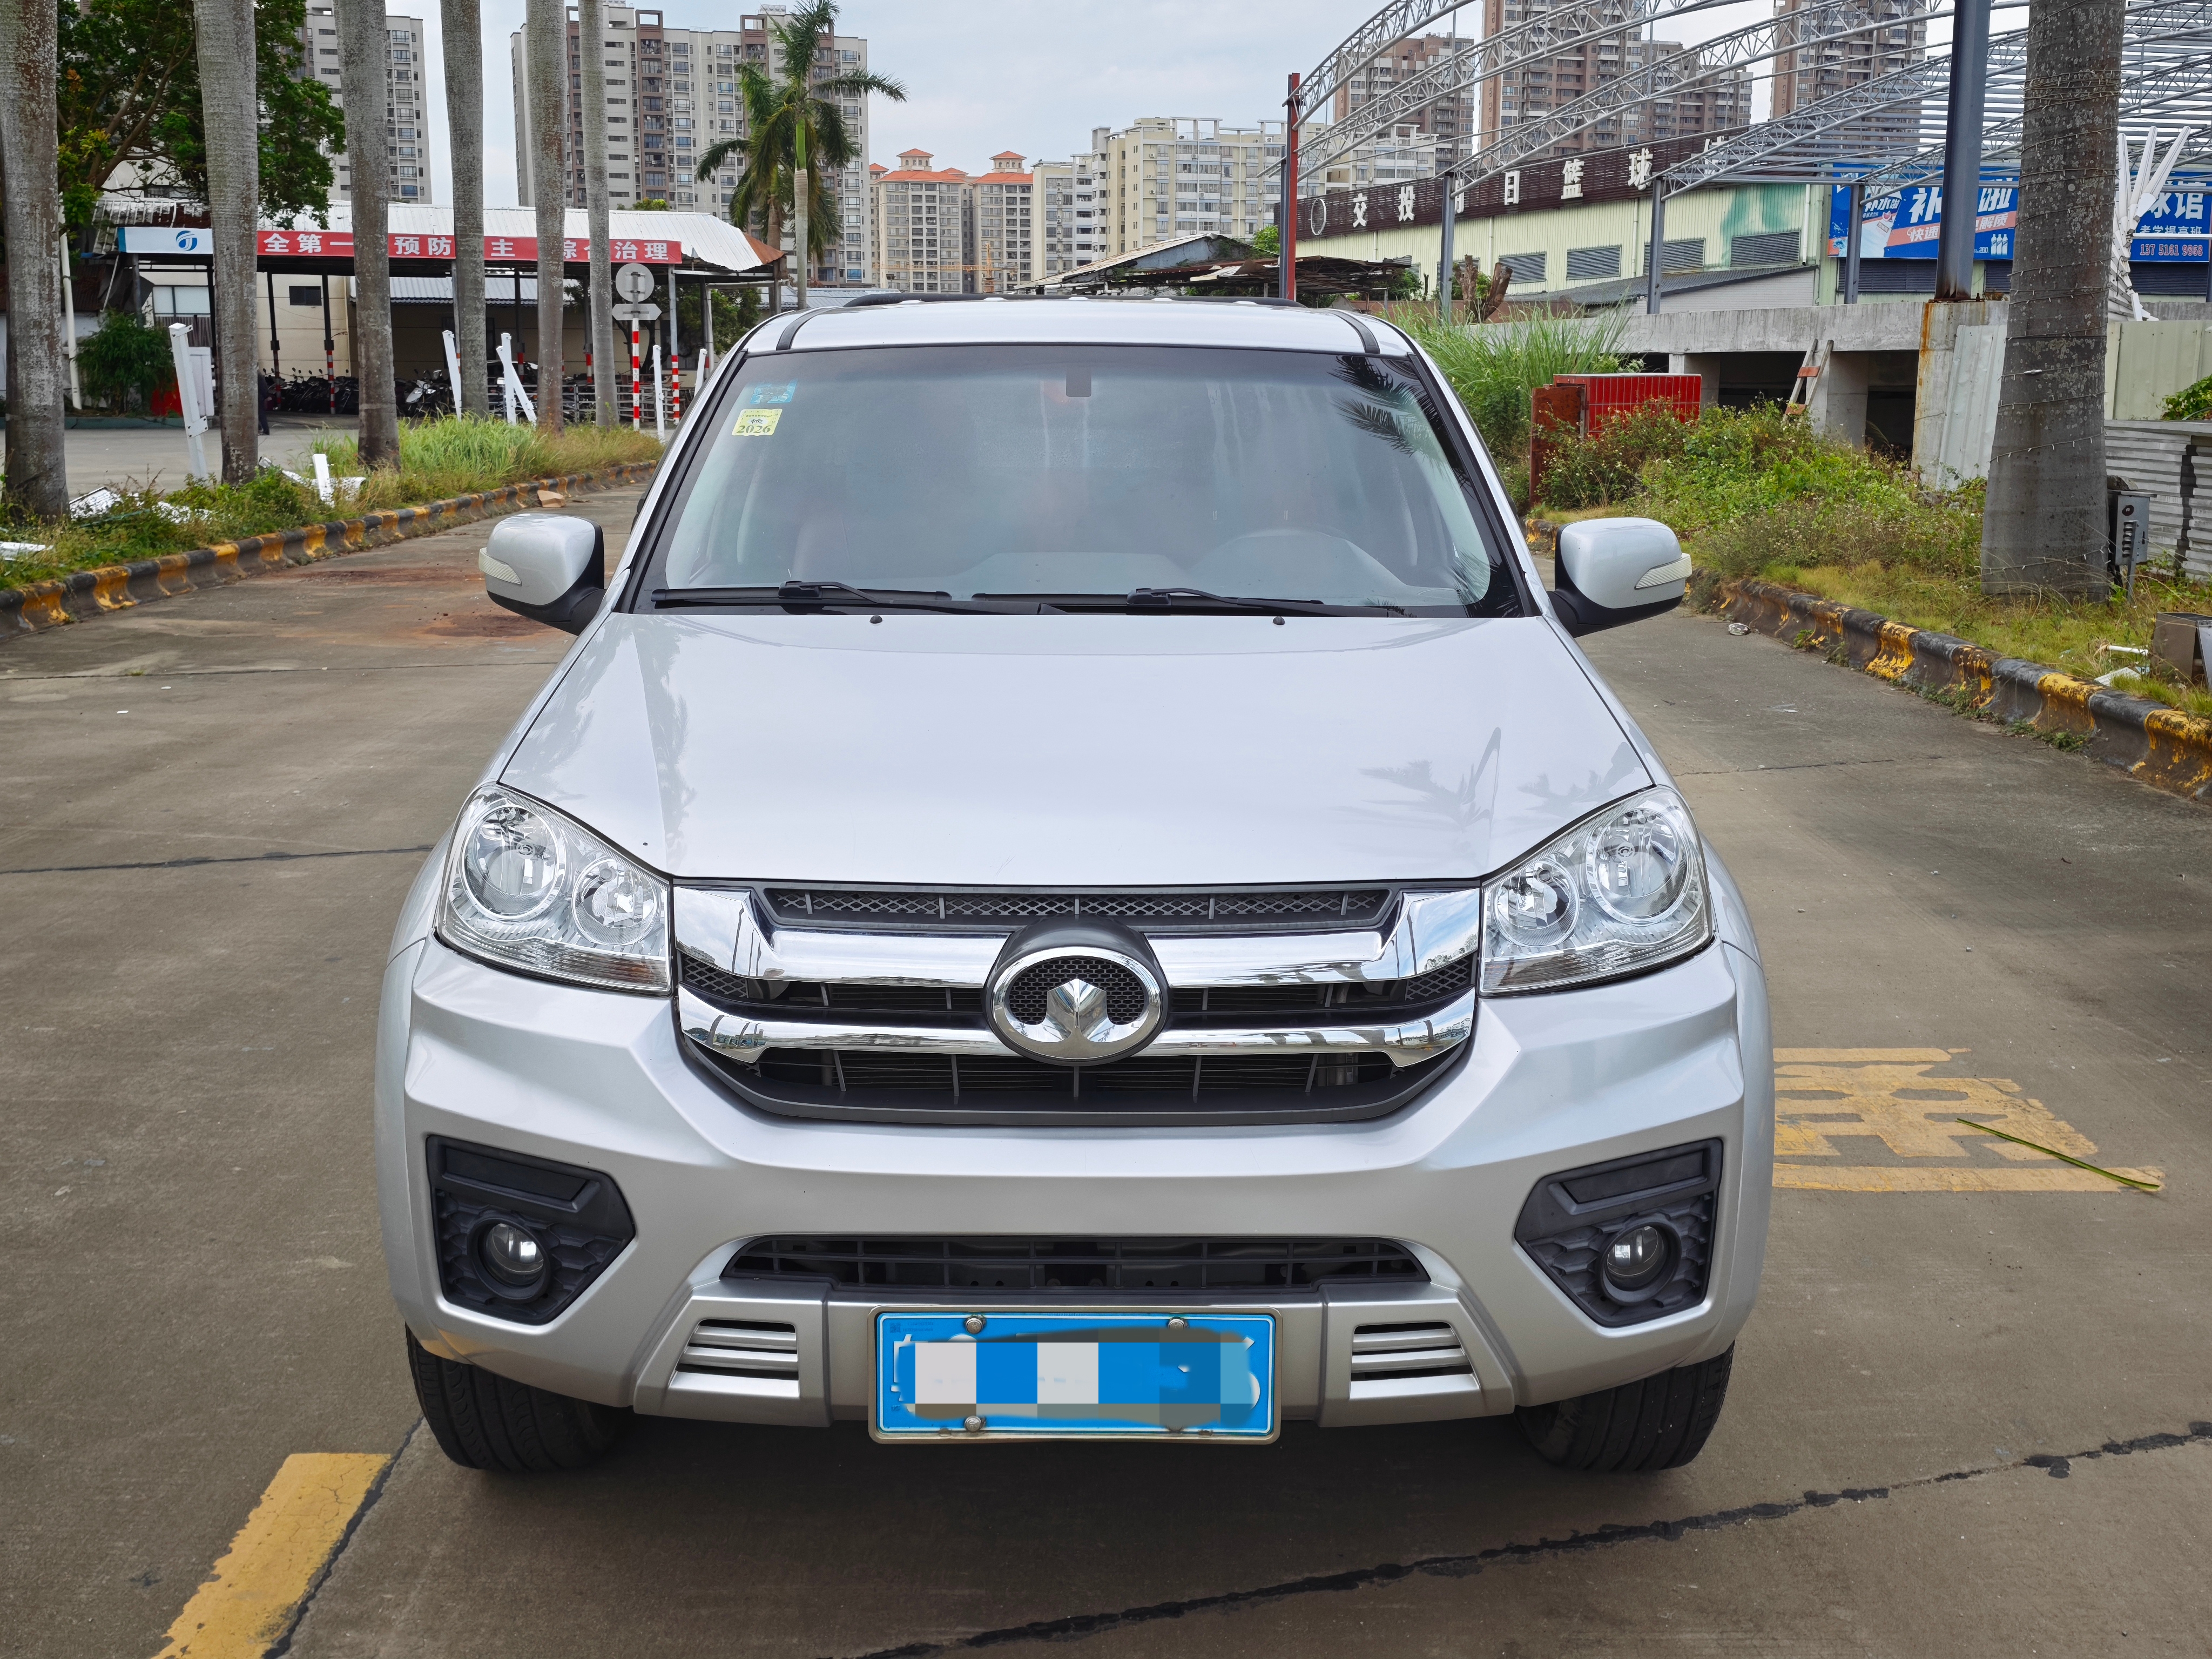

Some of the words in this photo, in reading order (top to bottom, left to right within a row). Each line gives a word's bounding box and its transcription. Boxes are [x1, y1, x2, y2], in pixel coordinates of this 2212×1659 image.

[1909, 178, 2013, 223] 补啦
[2140, 244, 2156, 256] 137
[2158, 244, 2180, 256] 5161
[2182, 244, 2203, 257] 9868
[736, 424, 772, 434] 2026
